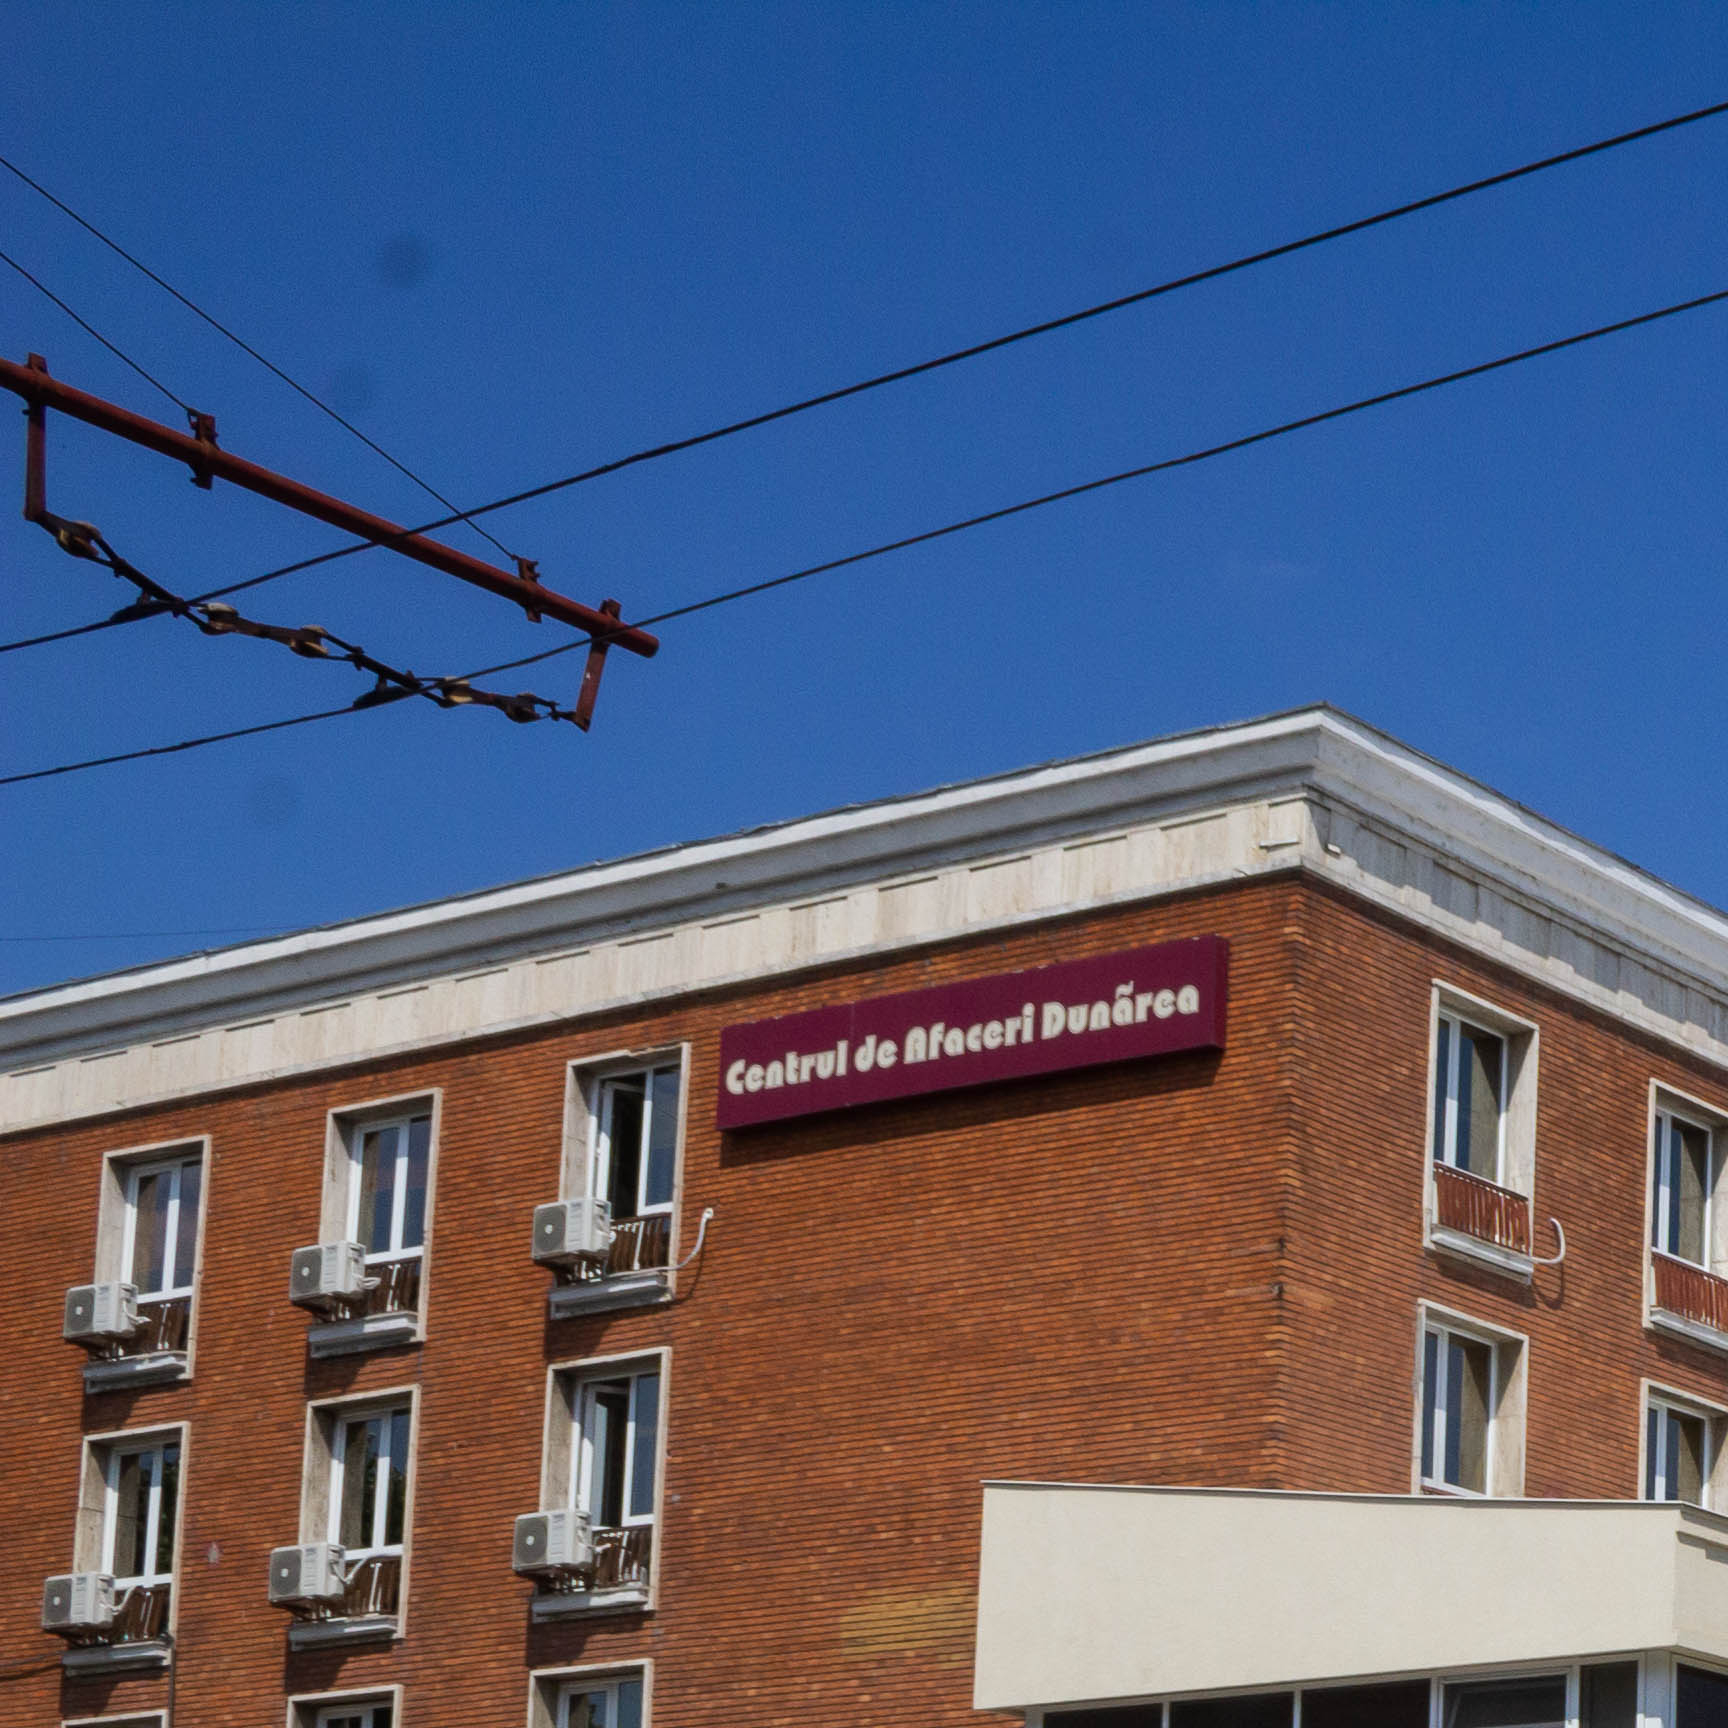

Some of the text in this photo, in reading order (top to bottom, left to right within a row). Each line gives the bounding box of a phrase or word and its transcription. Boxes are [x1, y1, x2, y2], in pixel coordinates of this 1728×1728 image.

[725, 1042, 848, 1096] Centrul
[855, 1033, 898, 1073] de
[904, 1004, 1035, 1065] Afaceri
